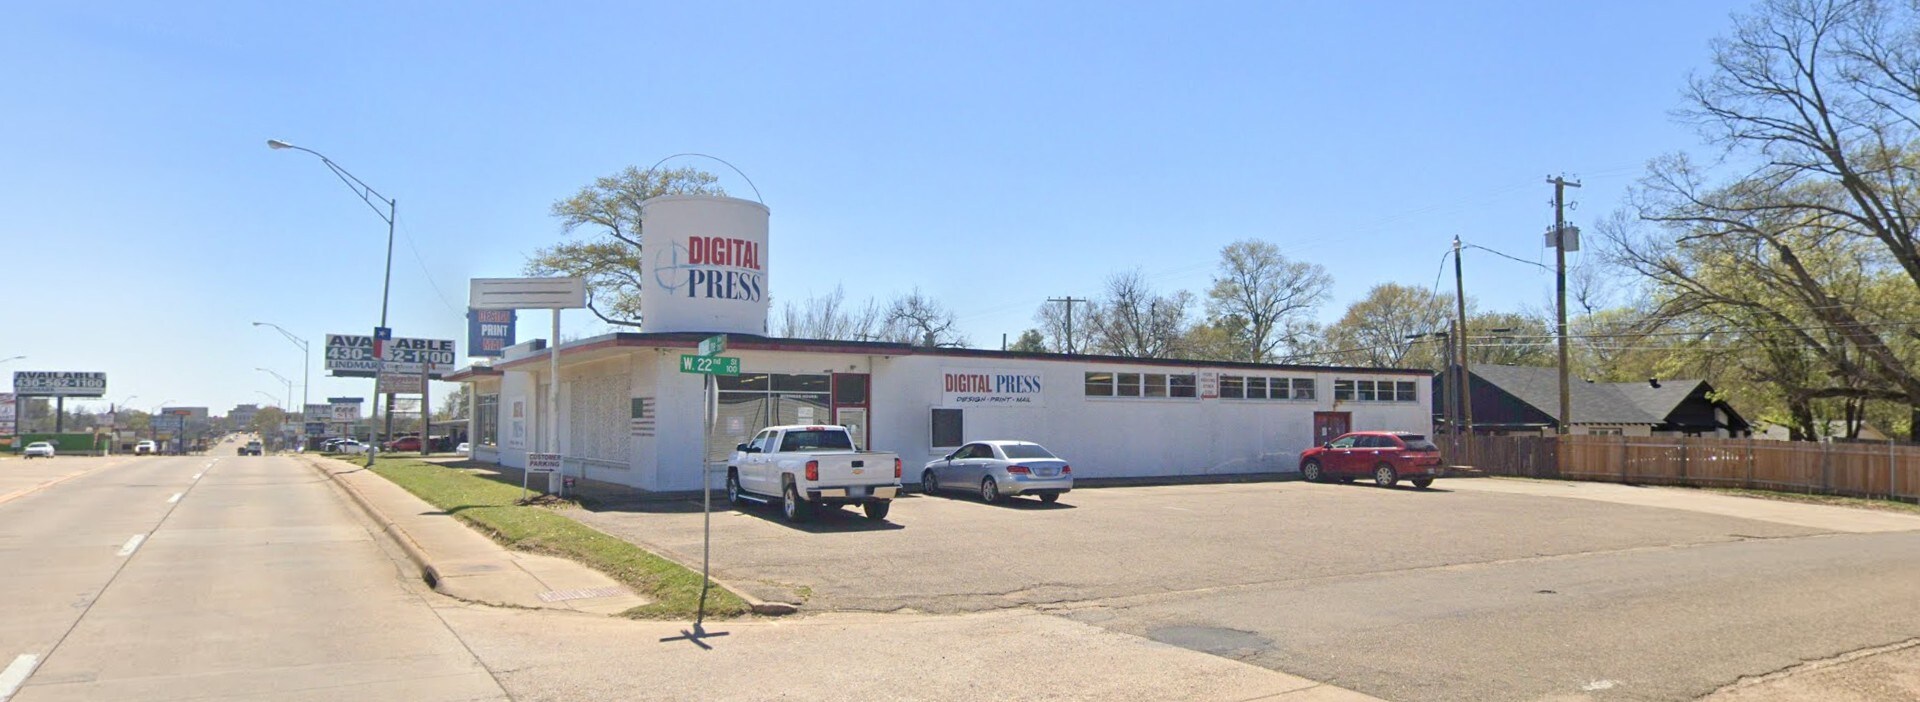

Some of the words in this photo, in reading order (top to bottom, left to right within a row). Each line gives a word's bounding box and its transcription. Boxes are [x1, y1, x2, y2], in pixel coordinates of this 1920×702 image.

[688, 236, 760, 270] DIGITAL
[688, 269, 760, 303] PRESS
[481, 324, 508, 336] PRINT
[329, 335, 453, 351] AVAABLE
[683, 357, 694, 371] W.
[726, 365, 738, 373] 100
[16, 371, 103, 379] AVAILABLE
[945, 373, 992, 393] DIGITAL
[995, 374, 1041, 394] PRESS
